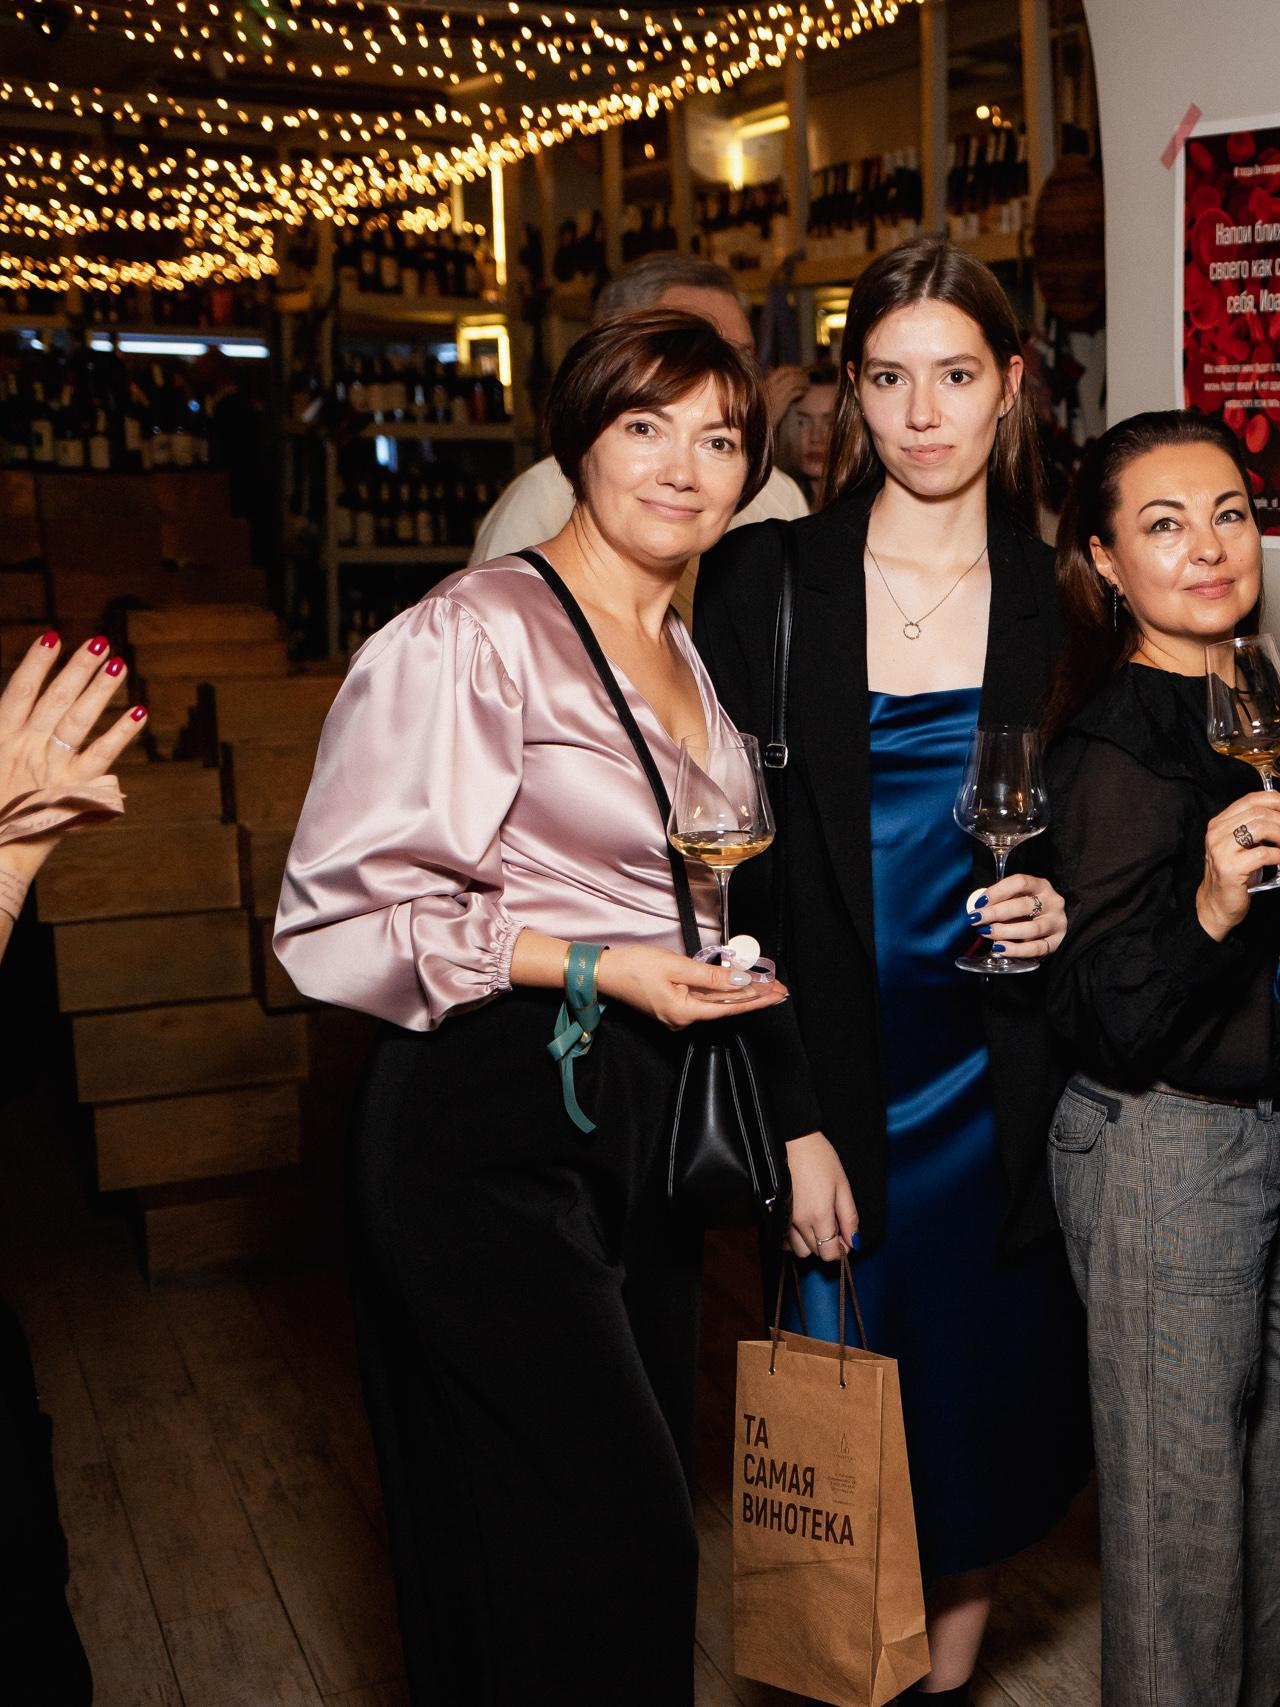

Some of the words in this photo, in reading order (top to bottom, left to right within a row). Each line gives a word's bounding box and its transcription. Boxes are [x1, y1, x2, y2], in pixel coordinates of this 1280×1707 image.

[1215, 222, 1252, 245] Напои
[1209, 260, 1250, 281] своего
[1251, 258, 1273, 278] как
[743, 1413, 769, 1449] ТА
[743, 1453, 815, 1498] САМАЯ
[742, 1491, 855, 1546] ВИНОТЕКА
